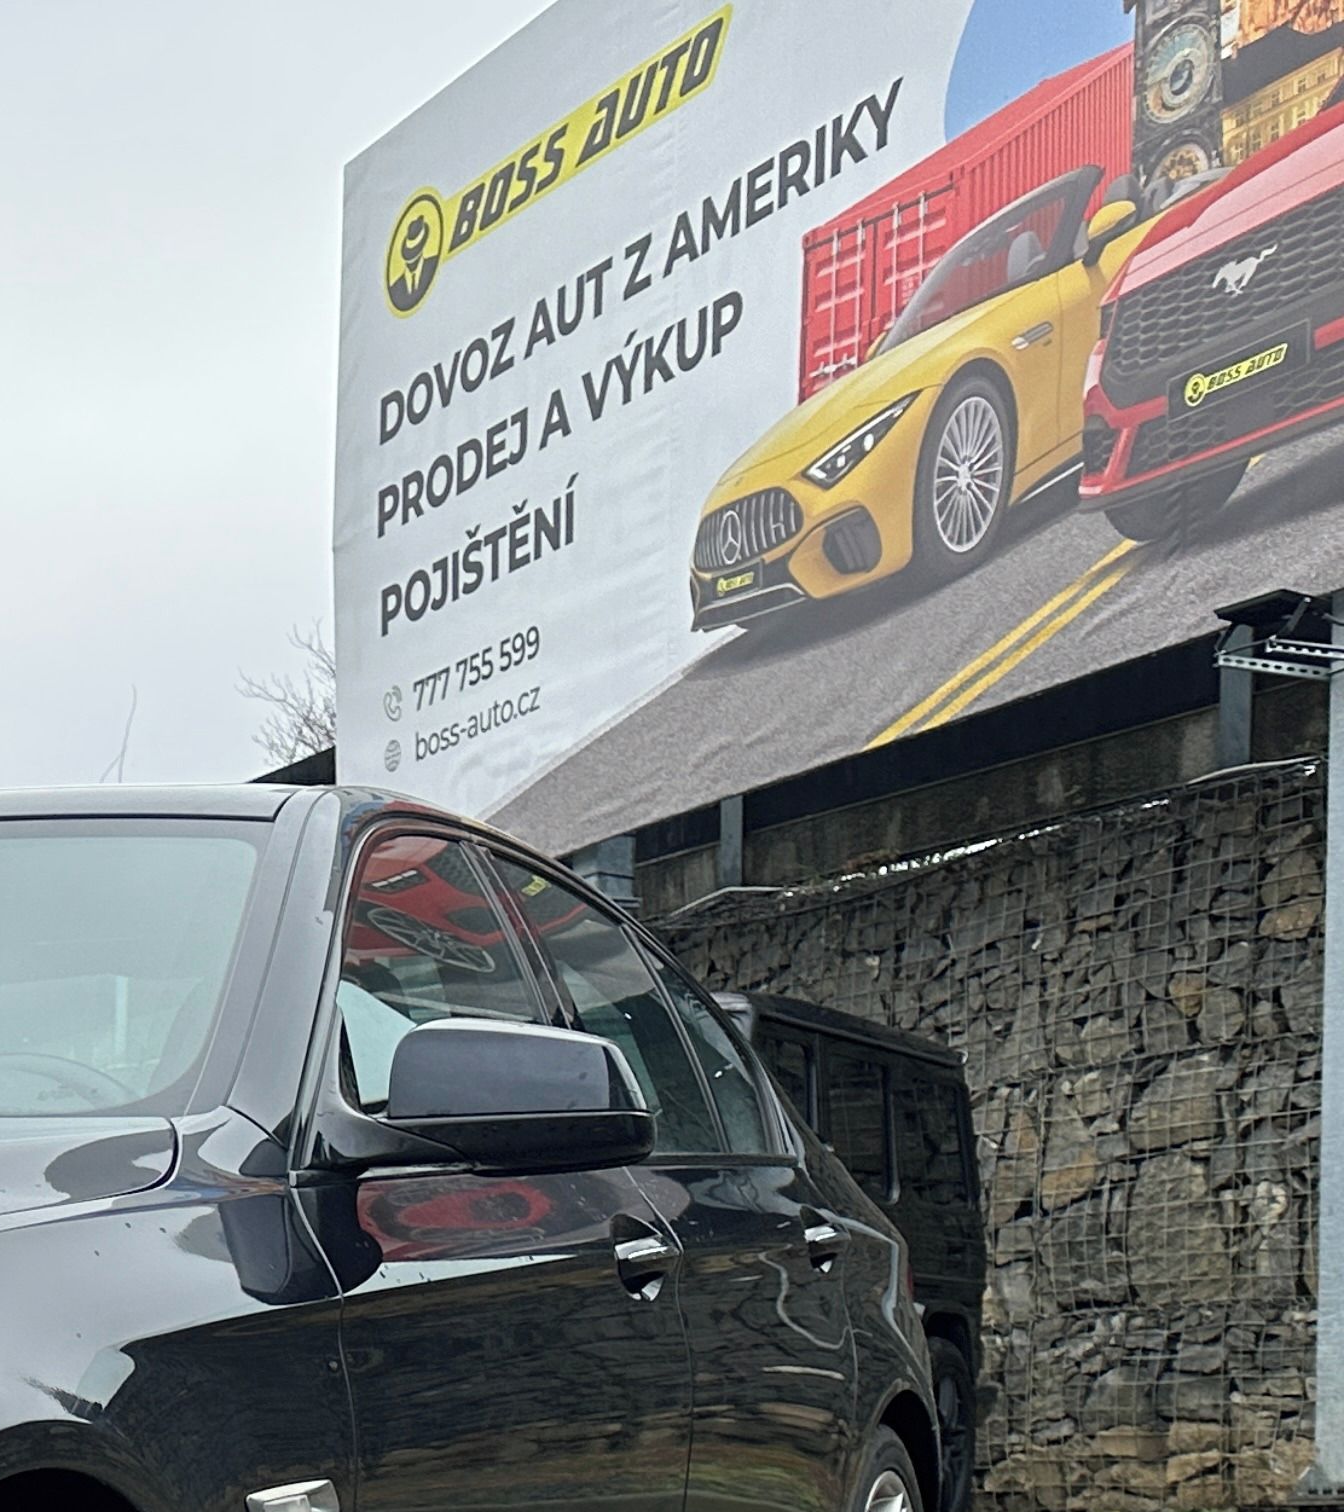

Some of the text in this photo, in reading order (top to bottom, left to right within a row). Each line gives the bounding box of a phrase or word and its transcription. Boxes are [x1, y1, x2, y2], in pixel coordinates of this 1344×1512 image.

[448, 17, 724, 254] BOSS AUTO
[379, 76, 904, 446] DOVOZ AUT Z AMERIKY
[377, 290, 744, 539] PRODEJ A VÝKUP
[380, 472, 579, 638] POJIŠTĚNÍ
[413, 625, 540, 712] 777 755 599
[414, 686, 541, 762] boss-auto.cz
